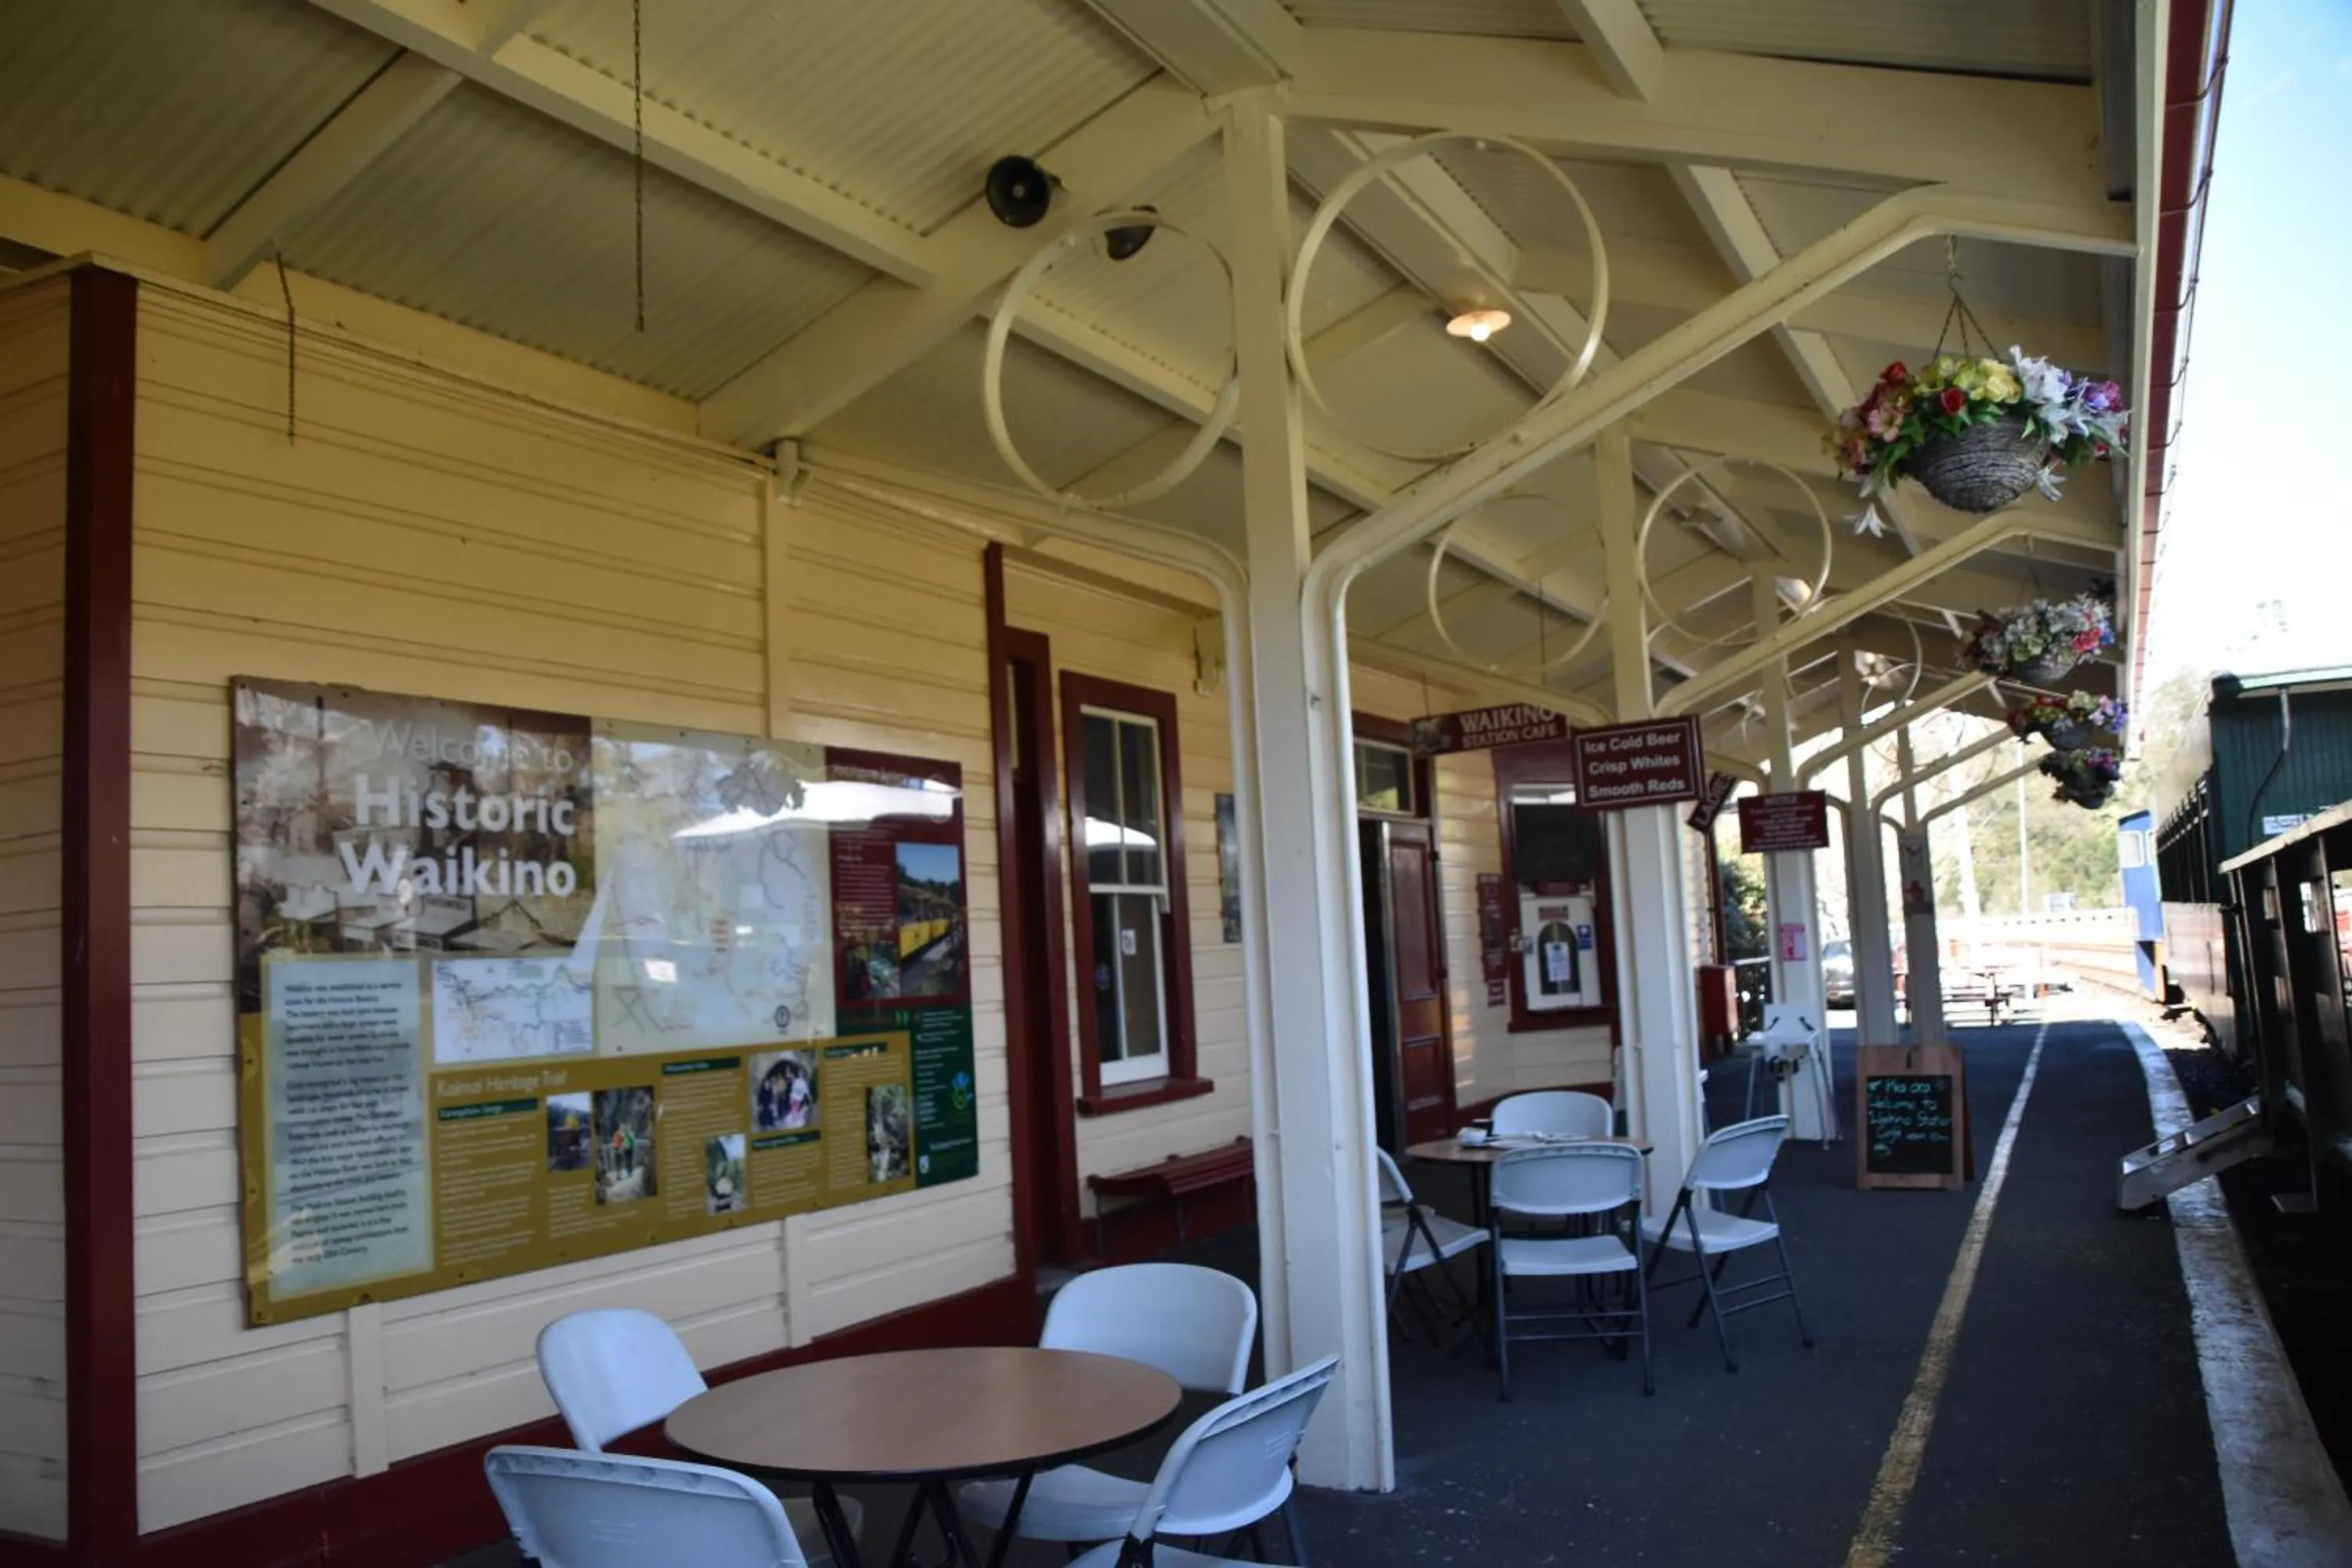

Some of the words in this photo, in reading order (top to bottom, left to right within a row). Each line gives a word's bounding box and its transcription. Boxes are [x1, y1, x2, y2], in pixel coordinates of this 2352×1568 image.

[1459, 706, 1556, 733] WAIKINO
[374, 719, 530, 771] Welcome
[541, 742, 574, 774] to
[1462, 728, 1519, 749] STATION
[1584, 741, 1606, 753] Ice
[1610, 735, 1643, 751] Cold
[1646, 731, 1681, 746] Beer
[1588, 760, 1628, 775] Crisp
[1629, 753, 1681, 770] Whites
[1588, 781, 1645, 798] Smooth
[1647, 777, 1685, 793] Reds
[355, 774, 575, 836] Historic
[339, 836, 577, 897] Waikino
